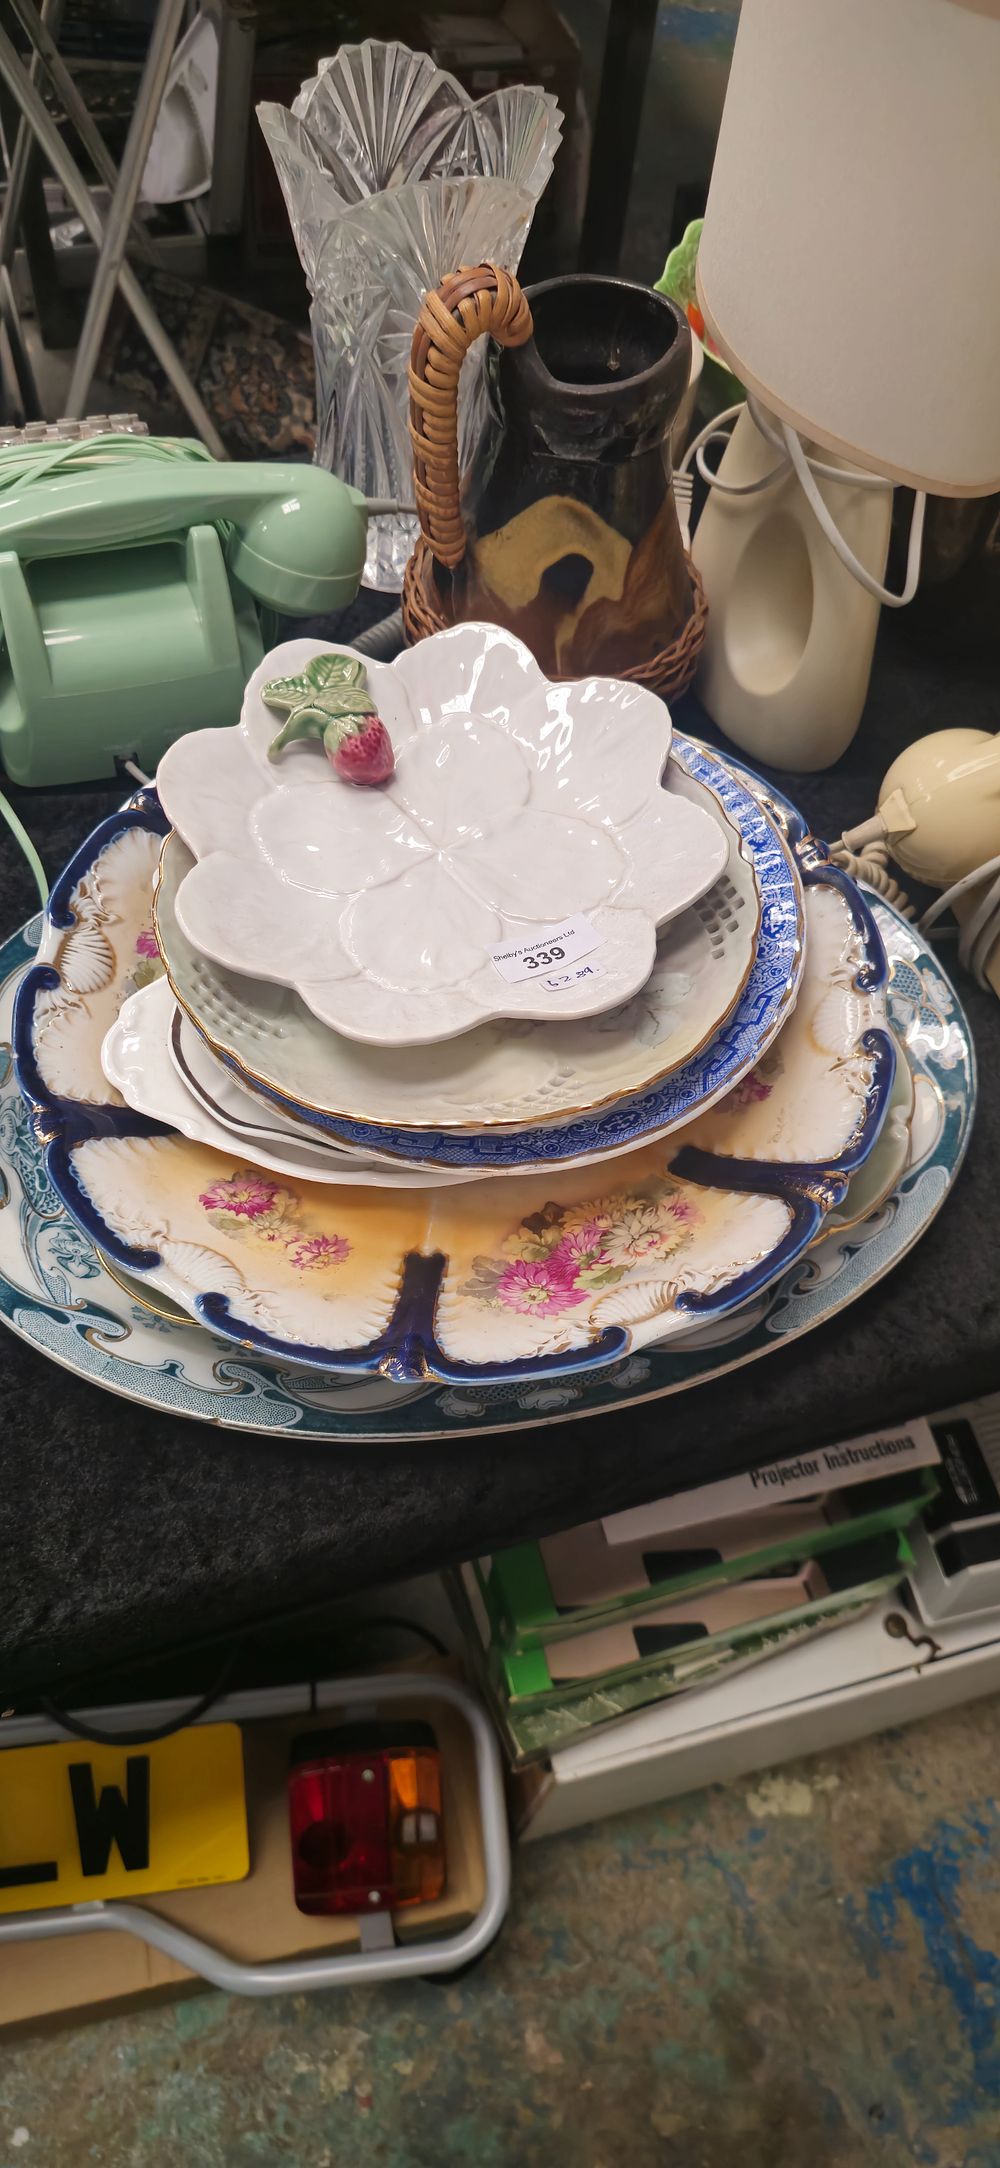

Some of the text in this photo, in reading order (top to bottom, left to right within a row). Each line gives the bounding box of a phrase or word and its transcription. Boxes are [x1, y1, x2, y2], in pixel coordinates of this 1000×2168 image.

[493, 929, 576, 962] Shelby's Auctioneers Ltd
[522, 946, 566, 969] 339
[749, 1459, 820, 1489] Projector
[822, 1435, 916, 1471] Instructions
